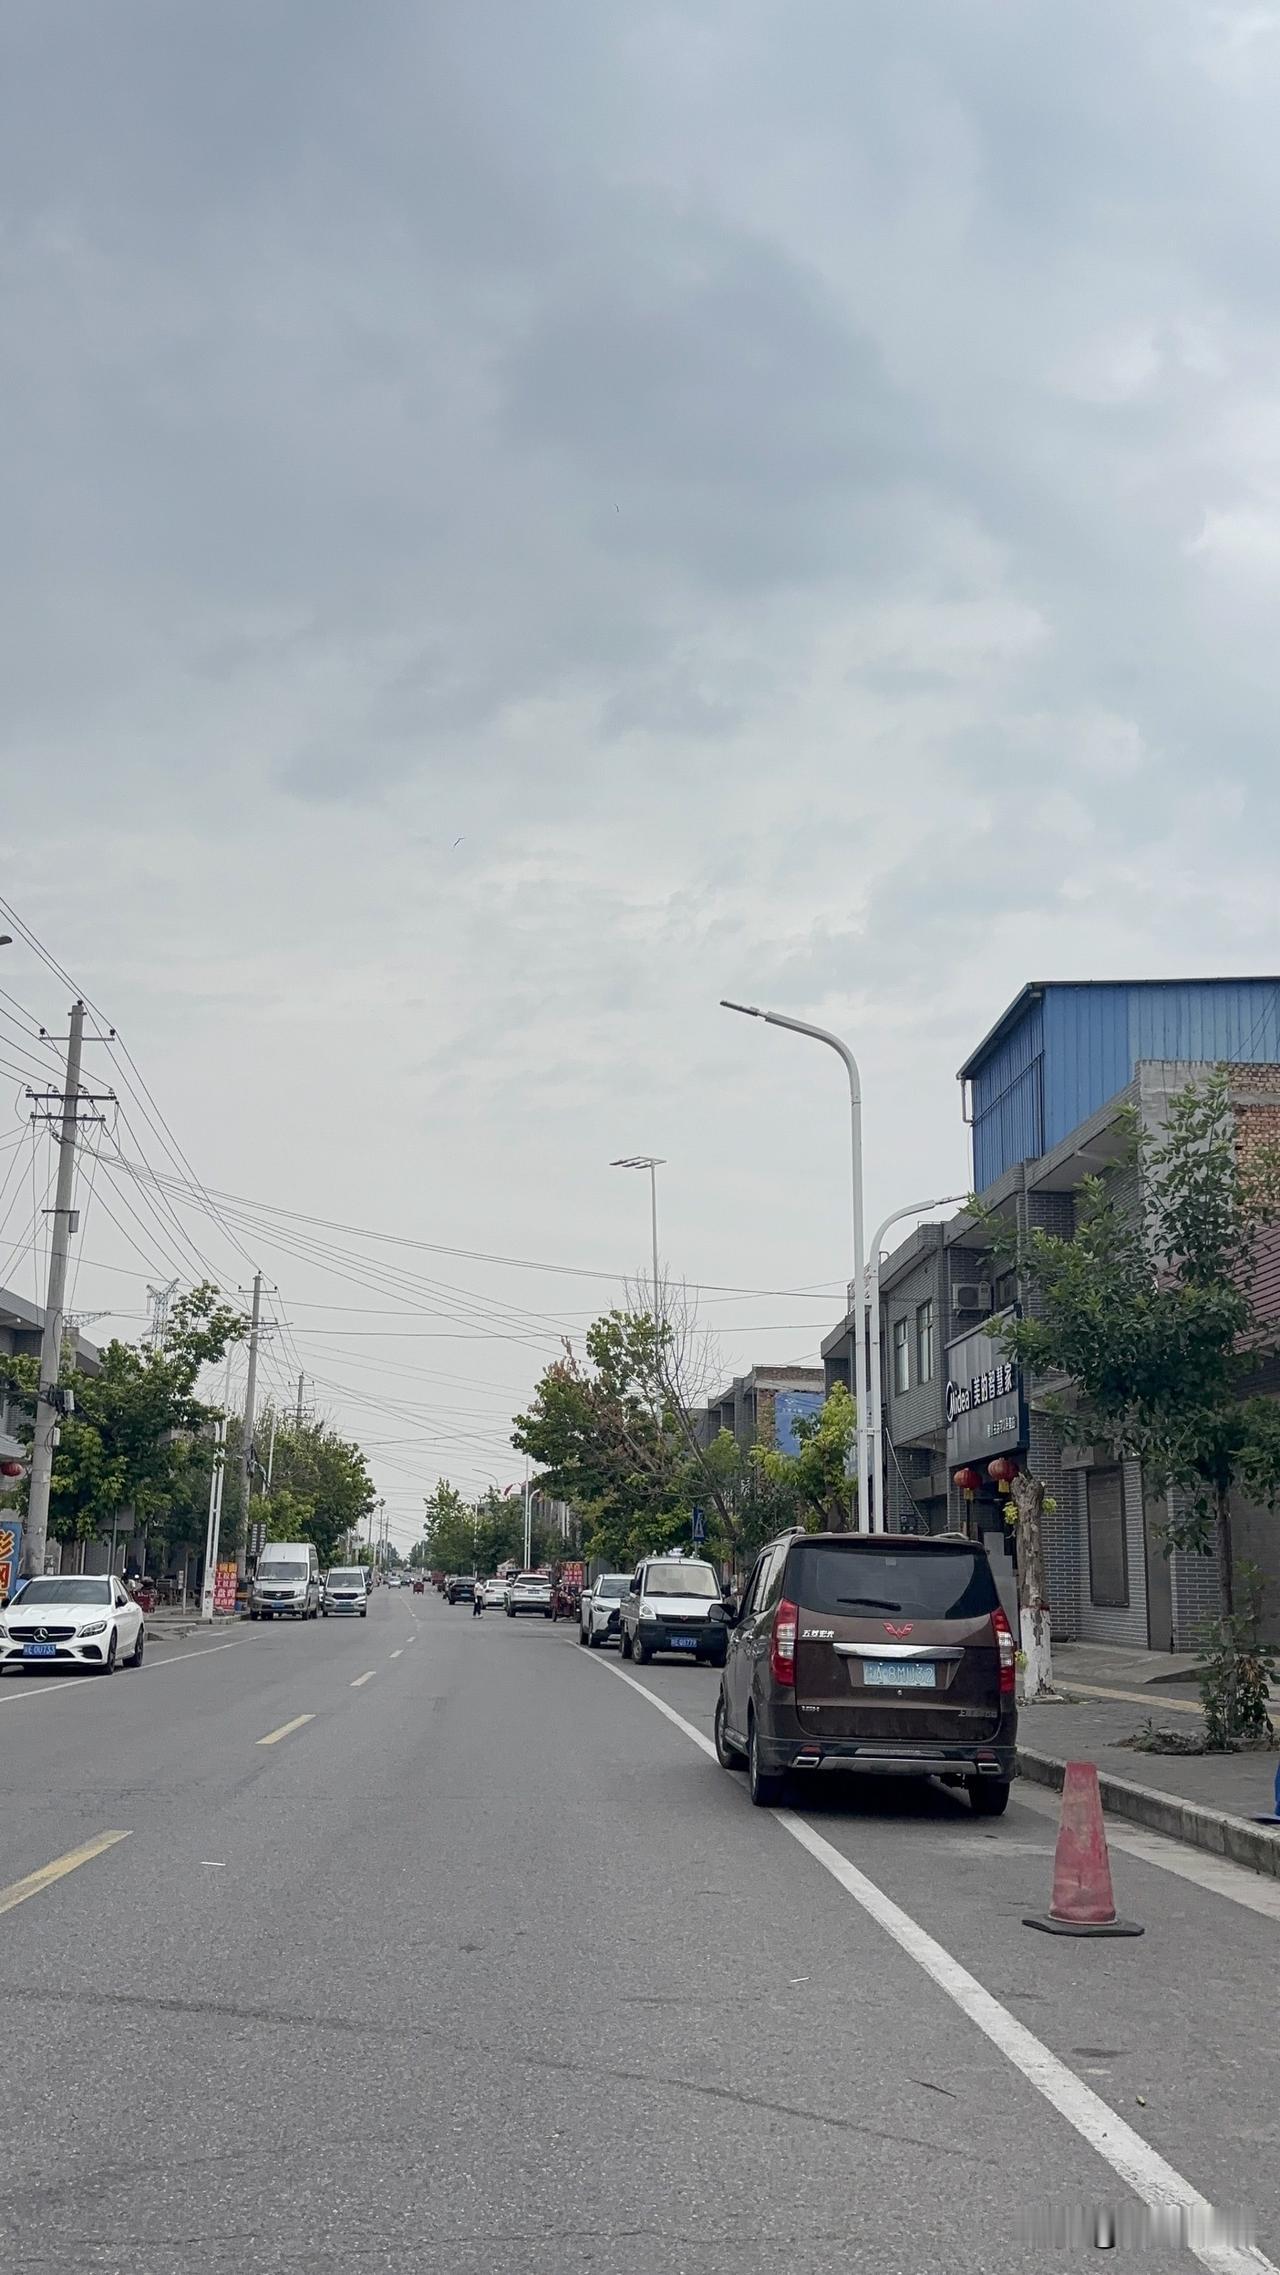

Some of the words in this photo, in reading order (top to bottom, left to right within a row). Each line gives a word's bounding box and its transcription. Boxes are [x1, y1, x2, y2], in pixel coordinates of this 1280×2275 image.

[946, 1380, 970, 1422] Midea
[973, 1361, 1012, 1406] 美的智慧家
